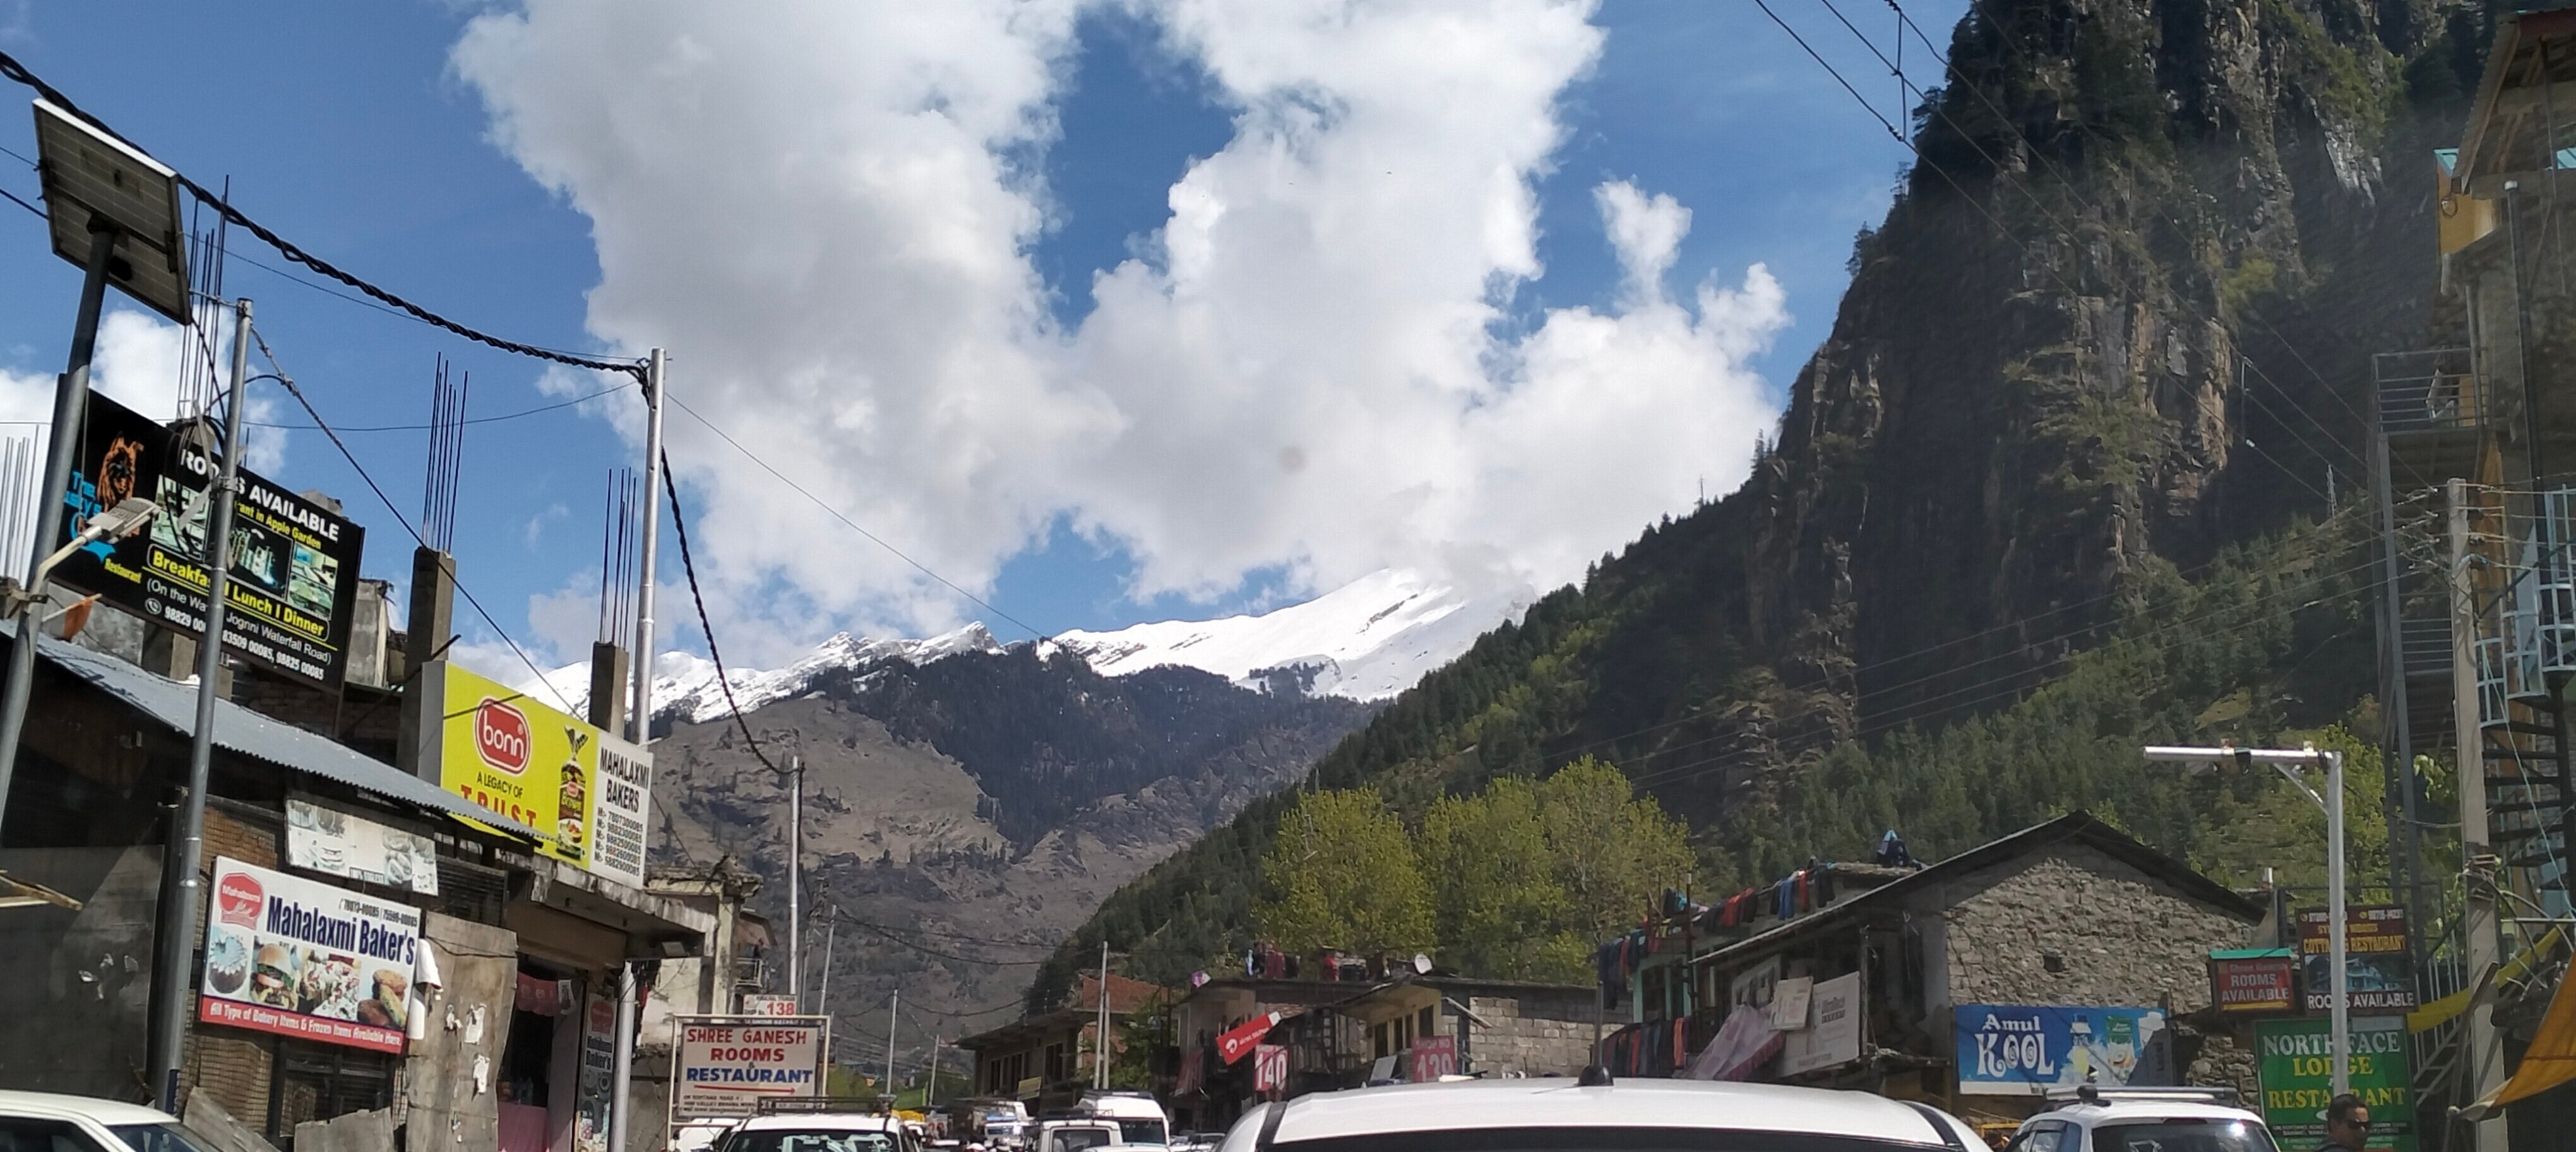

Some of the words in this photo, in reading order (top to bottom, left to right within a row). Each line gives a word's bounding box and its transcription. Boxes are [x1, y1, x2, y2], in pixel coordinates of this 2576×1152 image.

[249, 485, 340, 541] AVAILABLE
[256, 511, 265, 523] in
[266, 515, 290, 535] Apple
[292, 527, 321, 549] Garden
[147, 579, 167, 596] (On
[170, 588, 186, 603] the
[190, 596, 208, 612] Wa
[226, 613, 259, 633] Jognni
[261, 625, 301, 651] Waterfall
[304, 643, 331, 665] Road)
[233, 585, 272, 615] Lunch
[283, 608, 324, 636] Dinner
[484, 710, 523, 759] bonn
[600, 747, 650, 789] MAHALAXMI
[477, 771, 482, 784] A
[484, 776, 512, 795] LEGACY
[513, 785, 523, 799] OF
[606, 779, 640, 813] BAKERS
[461, 784, 536, 827] TRUST
[266, 895, 357, 952] Mahalaxmi
[359, 919, 415, 966] Baker's
[2351, 935, 2406, 952] RESTAURANT
[2222, 988, 2289, 1002] AVAILABLE
[2231, 973, 2277, 987] ROOMS
[767, 1002, 794, 1015] 138
[2307, 994, 2351, 1009] ROOS
[2354, 992, 2414, 1008] AVAILABLE
[210, 1002, 222, 1016] All
[224, 1004, 242, 1021] Type
[243, 1009, 251, 1020] of
[253, 1009, 278, 1028] Bakery
[280, 1014, 299, 1029] Items
[301, 1018, 307, 1031] &
[308, 1019, 331, 1034] Frozen
[333, 1024, 352, 1038] Items
[1983, 1014, 2041, 1031] Amul
[686, 1028, 733, 1043] SHREE
[742, 1029, 807, 1044] GANESH
[2347, 1032, 2400, 1053] FACE
[710, 1048, 785, 1062] ROOMS
[1974, 1033, 2054, 1077] KOOL
[686, 1067, 813, 1083] RESTAURANT
[1255, 1053, 1287, 1091] 140
[2269, 1088, 2406, 1108] RESTARANT
